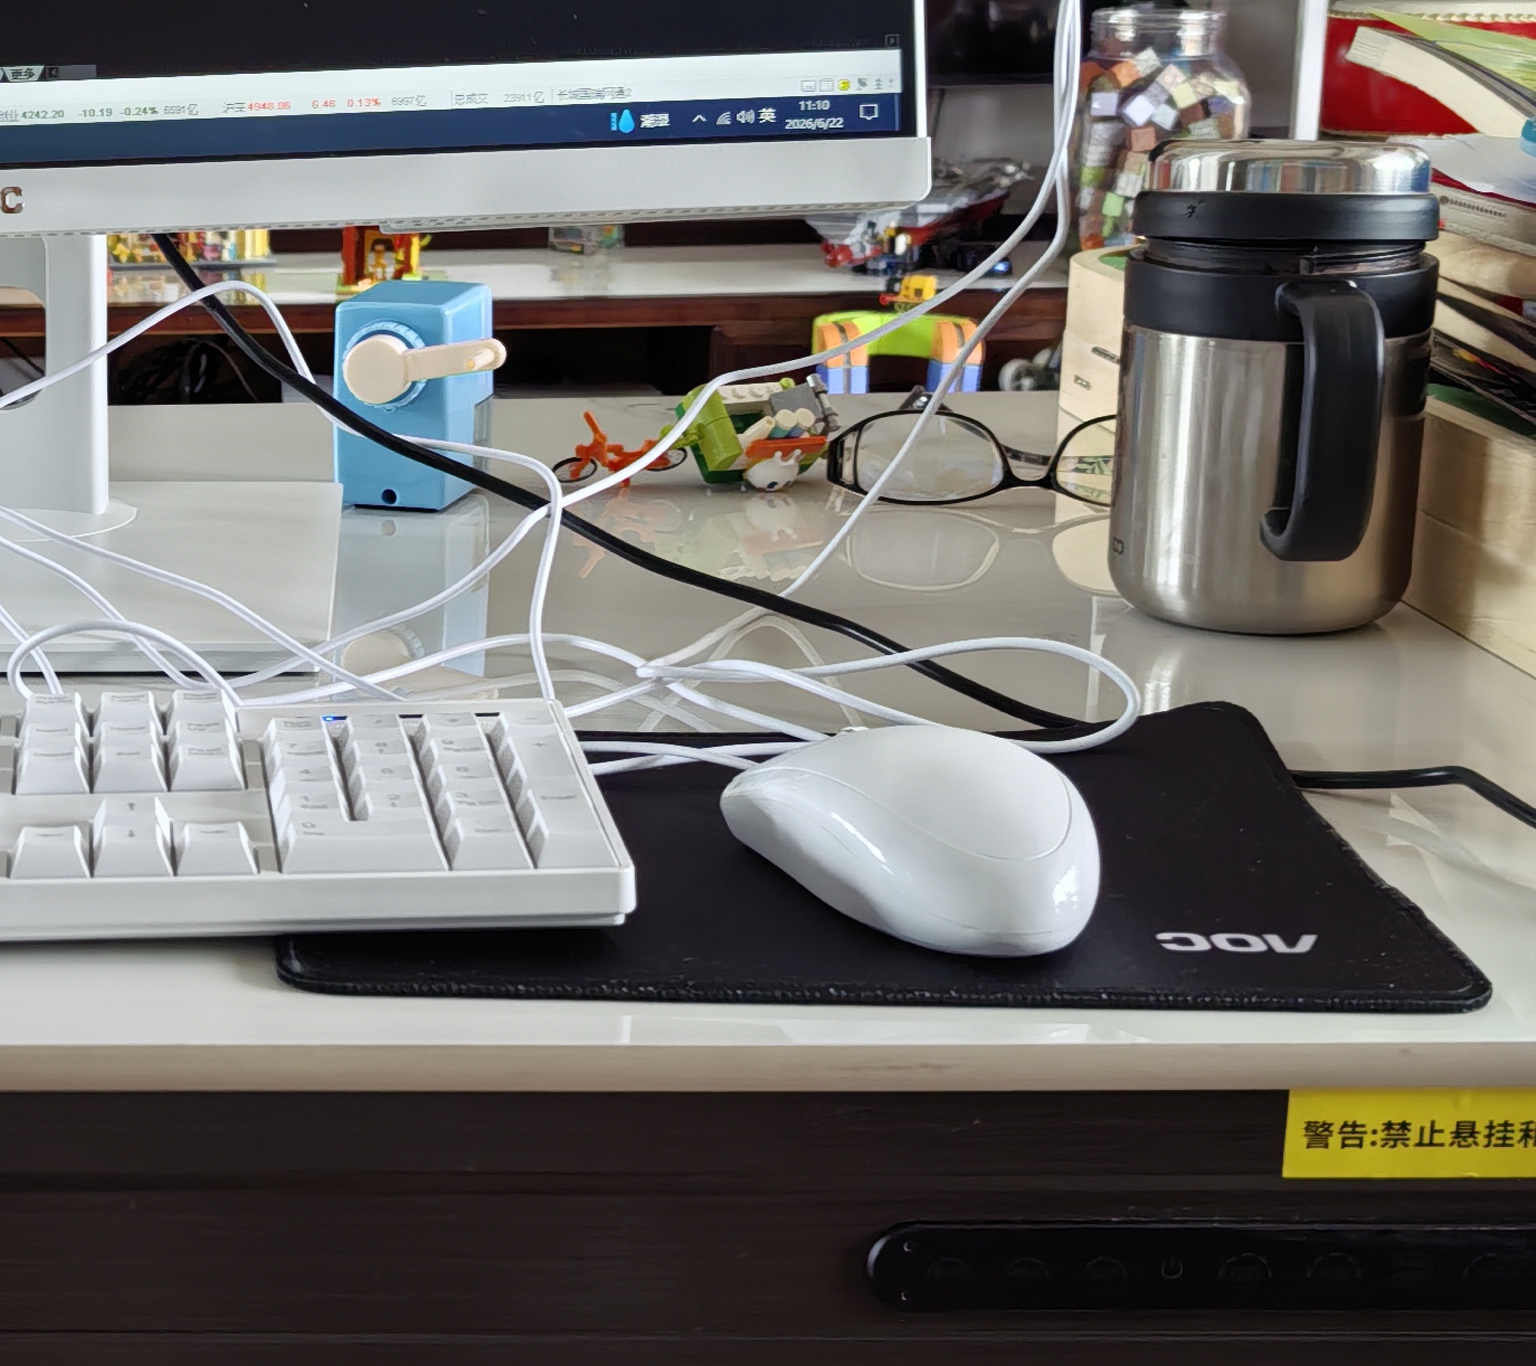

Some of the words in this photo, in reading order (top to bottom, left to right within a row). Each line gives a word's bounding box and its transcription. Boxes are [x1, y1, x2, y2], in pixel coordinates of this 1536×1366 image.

[11, 68, 35, 80] 更多
[798, 100, 830, 111] 11:10
[758, 108, 777, 123] 英
[785, 117, 844, 131] 2026/6/22
[1155, 932, 1318, 954] AOC
